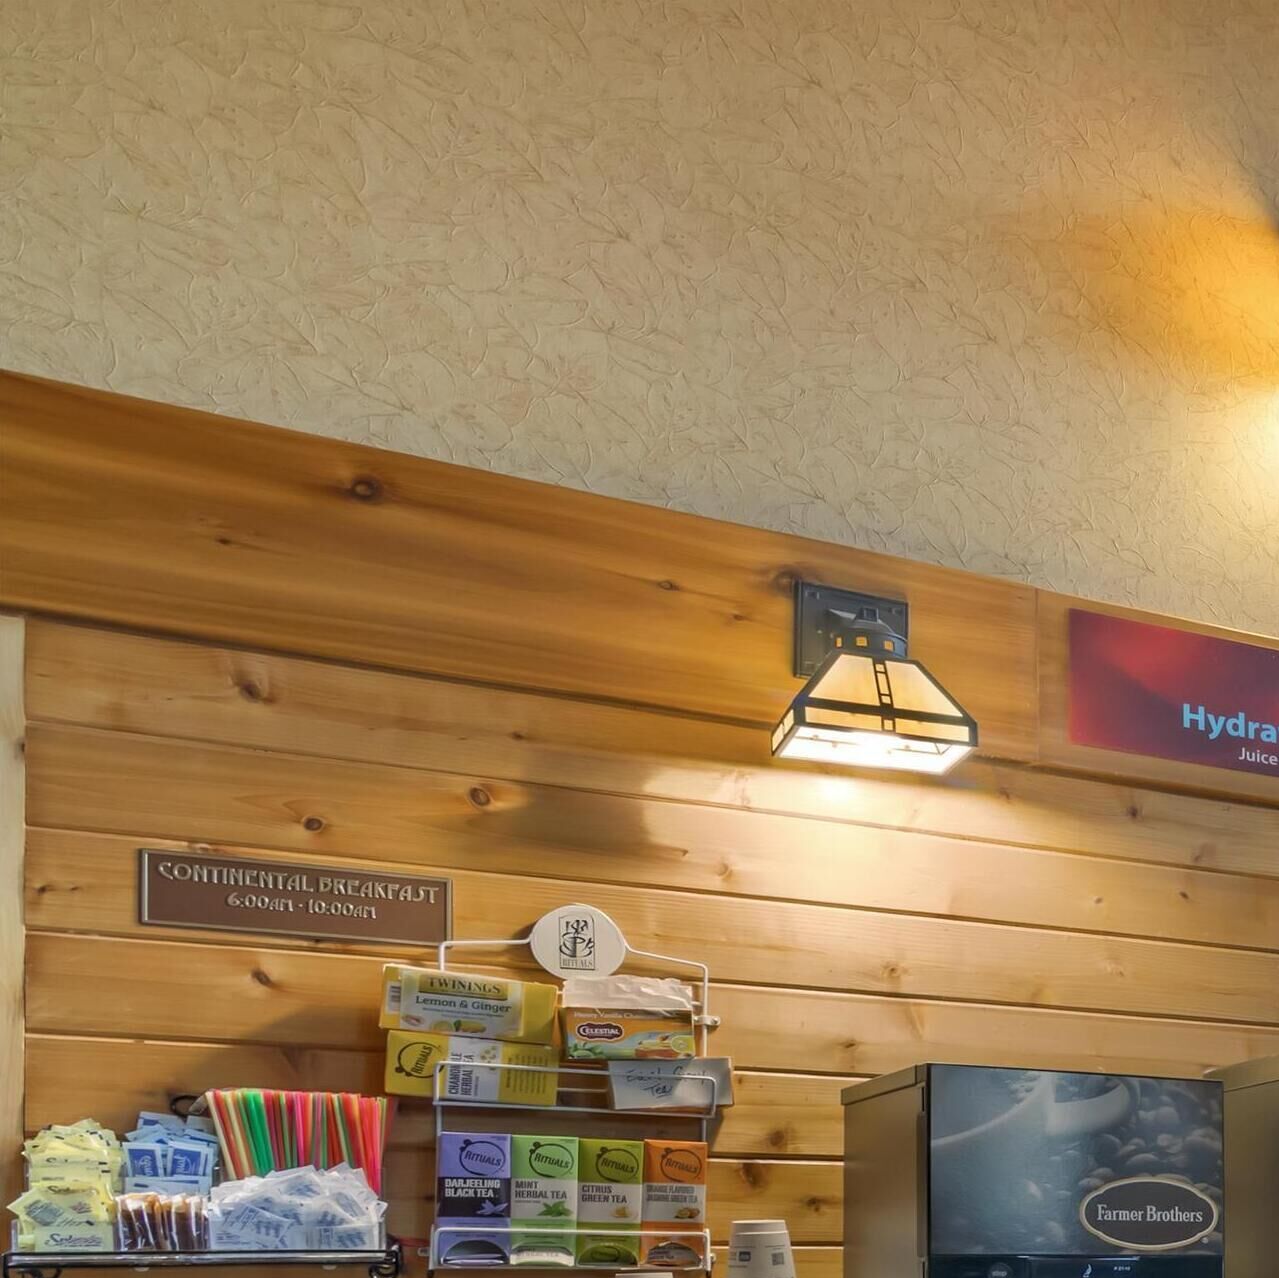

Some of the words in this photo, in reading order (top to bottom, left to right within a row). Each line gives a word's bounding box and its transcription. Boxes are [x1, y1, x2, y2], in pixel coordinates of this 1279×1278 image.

[1238, 747, 1278, 766] Juice
[157, 860, 314, 893] CONTINENTAL
[318, 876, 440, 905] BREAKFAST
[225, 892, 294, 912] 6:00AM
[308, 898, 377, 920] 10:00AM
[428, 976, 502, 994] TWININGS
[415, 995, 457, 1008] Lemon
[459, 1000, 468, 1009] &
[471, 1000, 512, 1013] Ginger
[410, 1045, 433, 1075] RITUALS
[461, 1069, 474, 1096] HERBAL
[464, 1150, 502, 1167] RITUALS
[534, 1153, 570, 1168] RITUALS
[600, 1158, 635, 1173] RITUALS
[665, 1158, 699, 1173] RITUALS
[444, 1178, 500, 1188] DARJEELING
[514, 1180, 539, 1189] MINT
[581, 1185, 613, 1193] CITRUS
[445, 1188, 479, 1198] BLACK
[480, 1189, 494, 1198] TEA
[514, 1190, 548, 1199] HERBAL
[550, 1190, 567, 1199] TEA
[581, 1194, 610, 1202] GREEN
[612, 1195, 627, 1203] TEA
[1097, 1204, 1144, 1221] Farmer
[1146, 1205, 1203, 1222] Brothers
